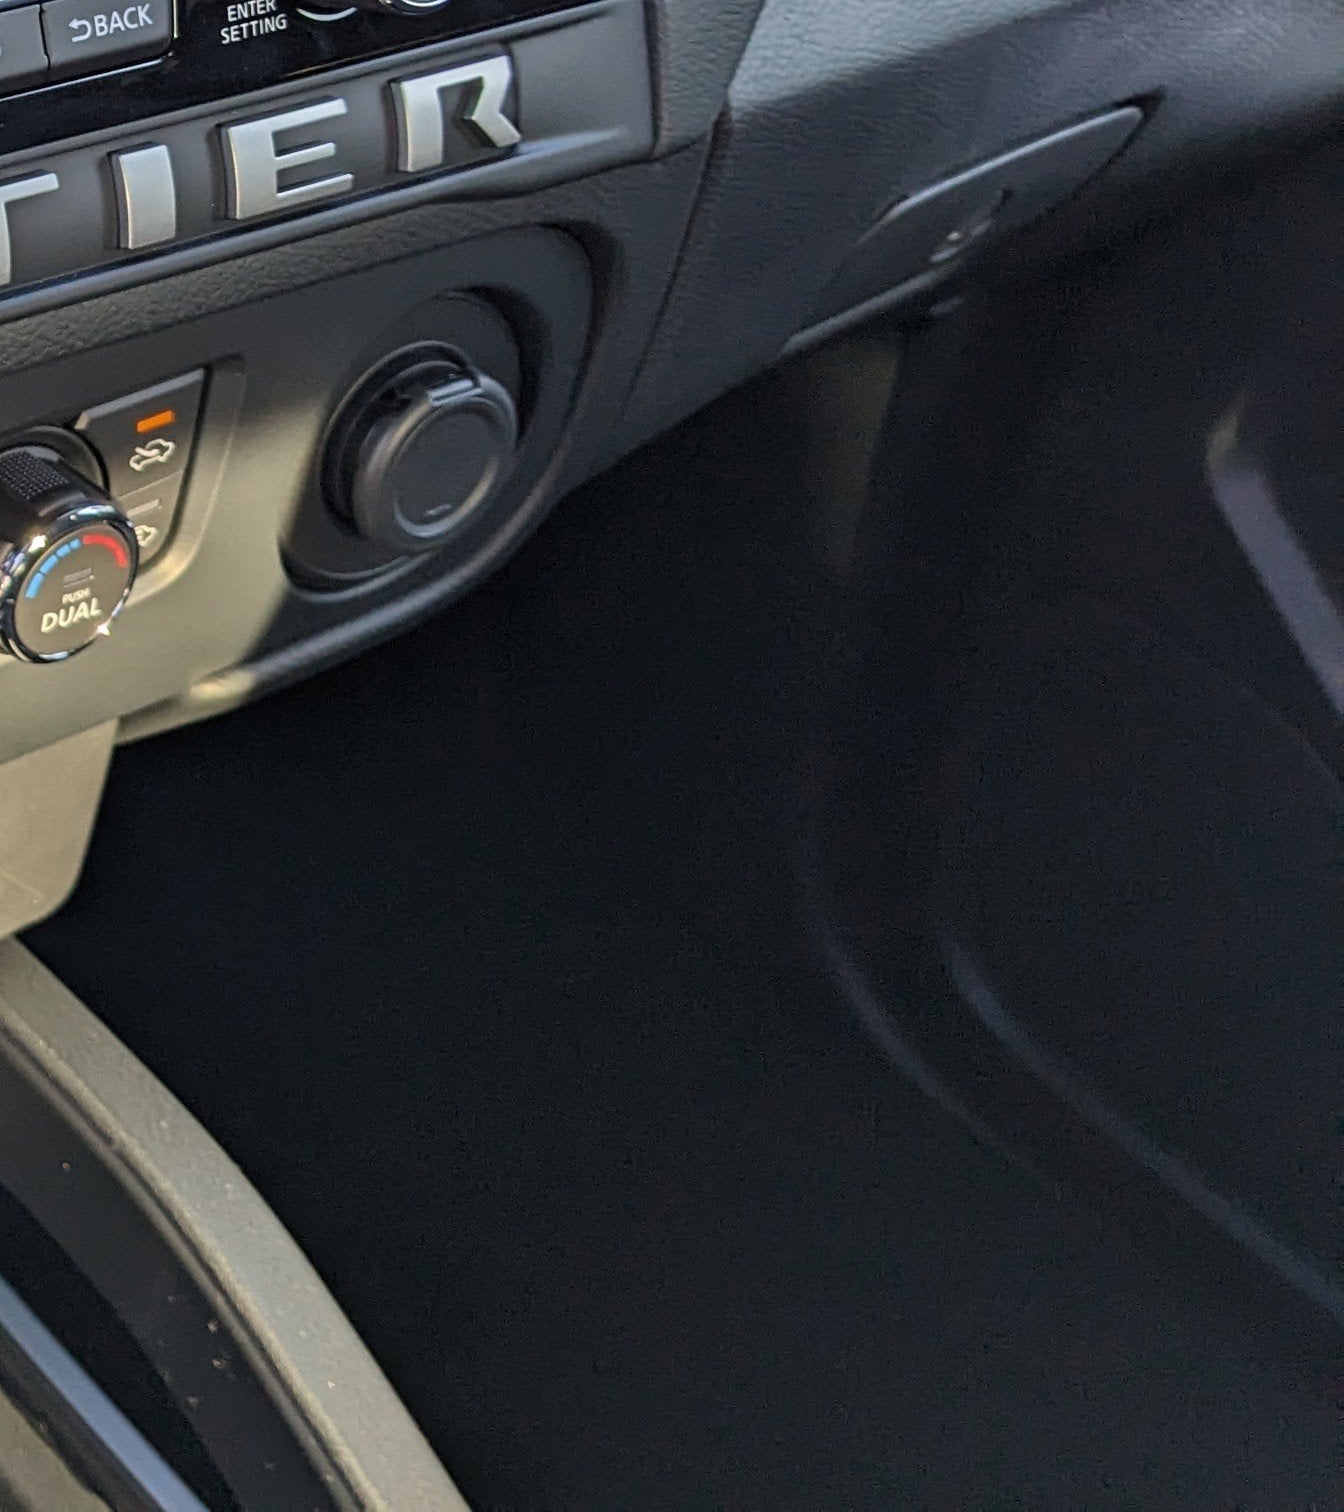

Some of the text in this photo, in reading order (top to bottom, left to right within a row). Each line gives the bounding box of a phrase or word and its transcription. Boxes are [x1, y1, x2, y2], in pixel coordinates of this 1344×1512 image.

[93, 3, 154, 37] BACK
[220, 13, 288, 45] SETTING
[40, 597, 102, 634] DUAL
